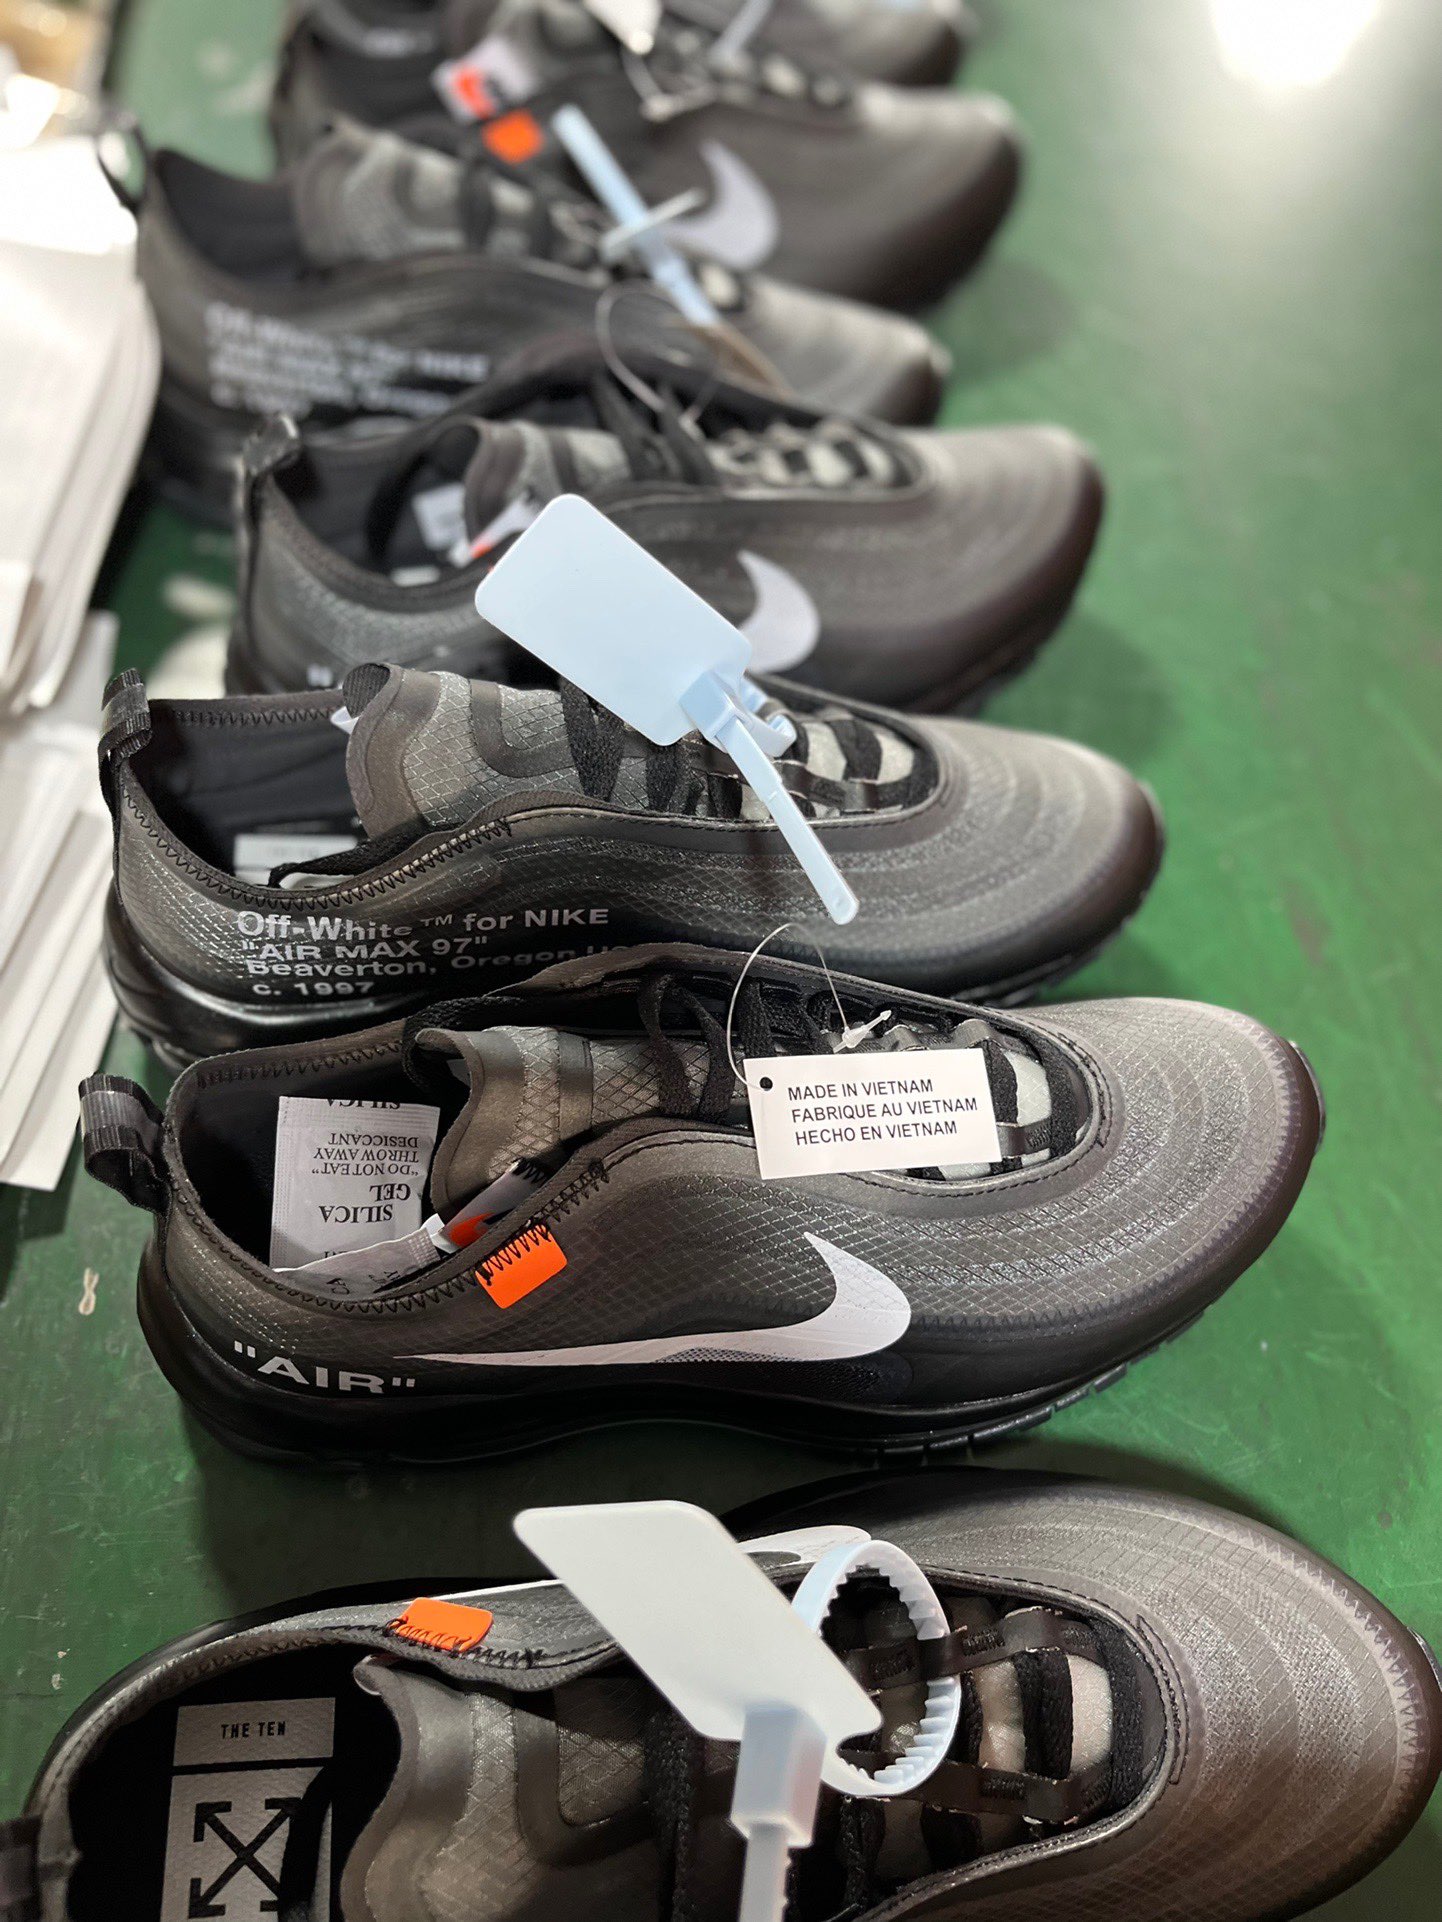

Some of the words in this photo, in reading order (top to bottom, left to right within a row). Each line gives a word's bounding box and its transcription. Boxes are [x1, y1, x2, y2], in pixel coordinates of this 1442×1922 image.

[237, 910, 413, 941] Off-White
[463, 913, 513, 931] for
[525, 908, 609, 928] NIKE
[242, 940, 321, 961] "AIR
[335, 940, 421, 960] MAX
[431, 936, 488, 956] 97"
[246, 959, 437, 977] Beaverton,
[451, 950, 576, 969] Oregon
[252, 983, 282, 996] c.
[294, 982, 374, 996] 1997
[788, 1084, 838, 1101] MADE
[841, 1083, 858, 1097] IN
[862, 1079, 934, 1096] VIETNAM
[792, 1104, 877, 1123] FABRIQUE
[881, 1102, 903, 1117] AU
[907, 1097, 978, 1115] VIETNAM
[328, 1133, 419, 1148] DESICCANT
[795, 1127, 856, 1146] HECHO
[860, 1126, 882, 1141] EN
[886, 1120, 958, 1138] VIETNAM
[313, 1148, 358, 1161] AWAY
[359, 1150, 419, 1163] THROW
[352, 1163, 385, 1176] NOT
[369, 1183, 411, 1202] GEL
[319, 1204, 393, 1224] SILICA
[234, 1340, 415, 1394] "AIR"
[221, 1723, 250, 1739] THE
[258, 1721, 286, 1737] TEN
